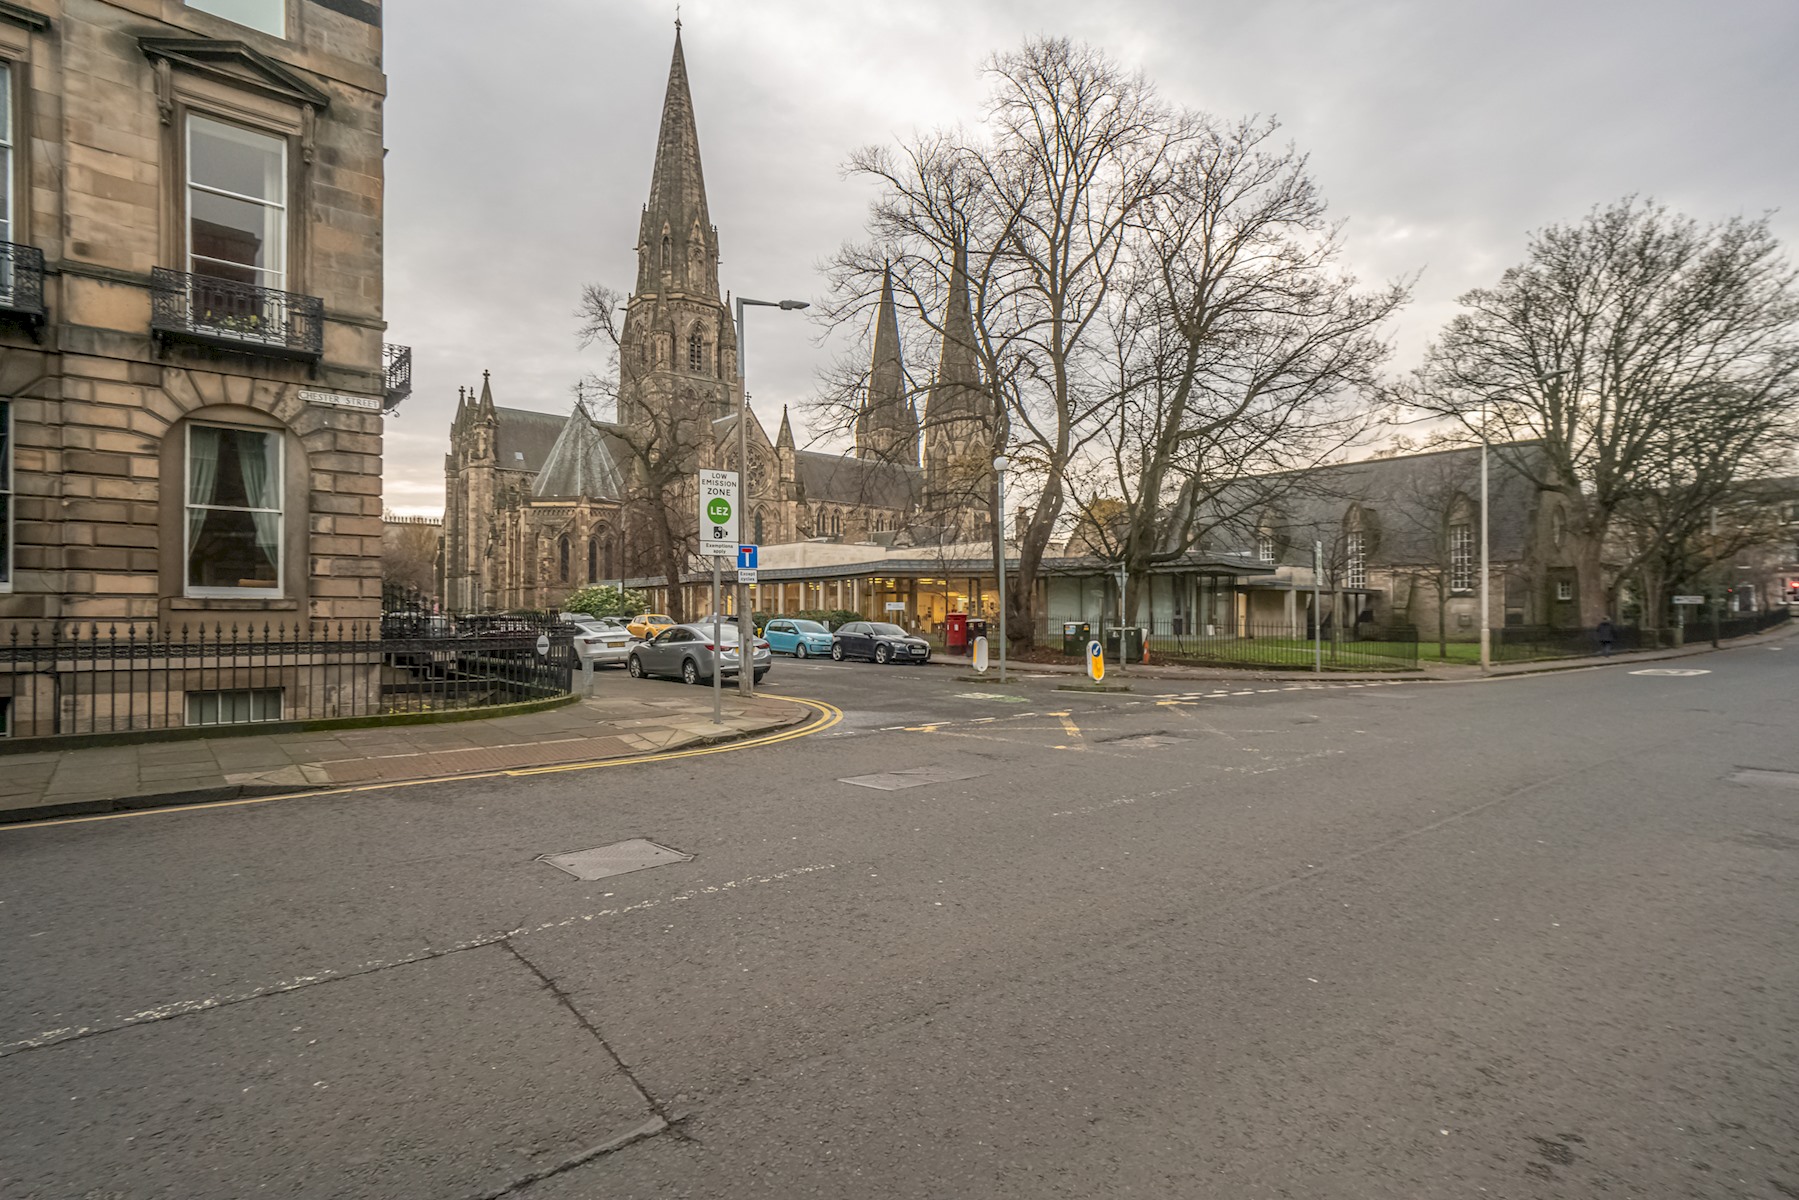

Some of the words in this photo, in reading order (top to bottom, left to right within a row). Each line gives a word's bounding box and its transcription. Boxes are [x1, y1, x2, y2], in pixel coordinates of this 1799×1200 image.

[300, 392, 339, 402] CHESTER
[346, 398, 377, 408] STREET
[702, 479, 736, 487] EMISSION
[708, 488, 731, 496] ZONE
[710, 506, 728, 515] LEZ
